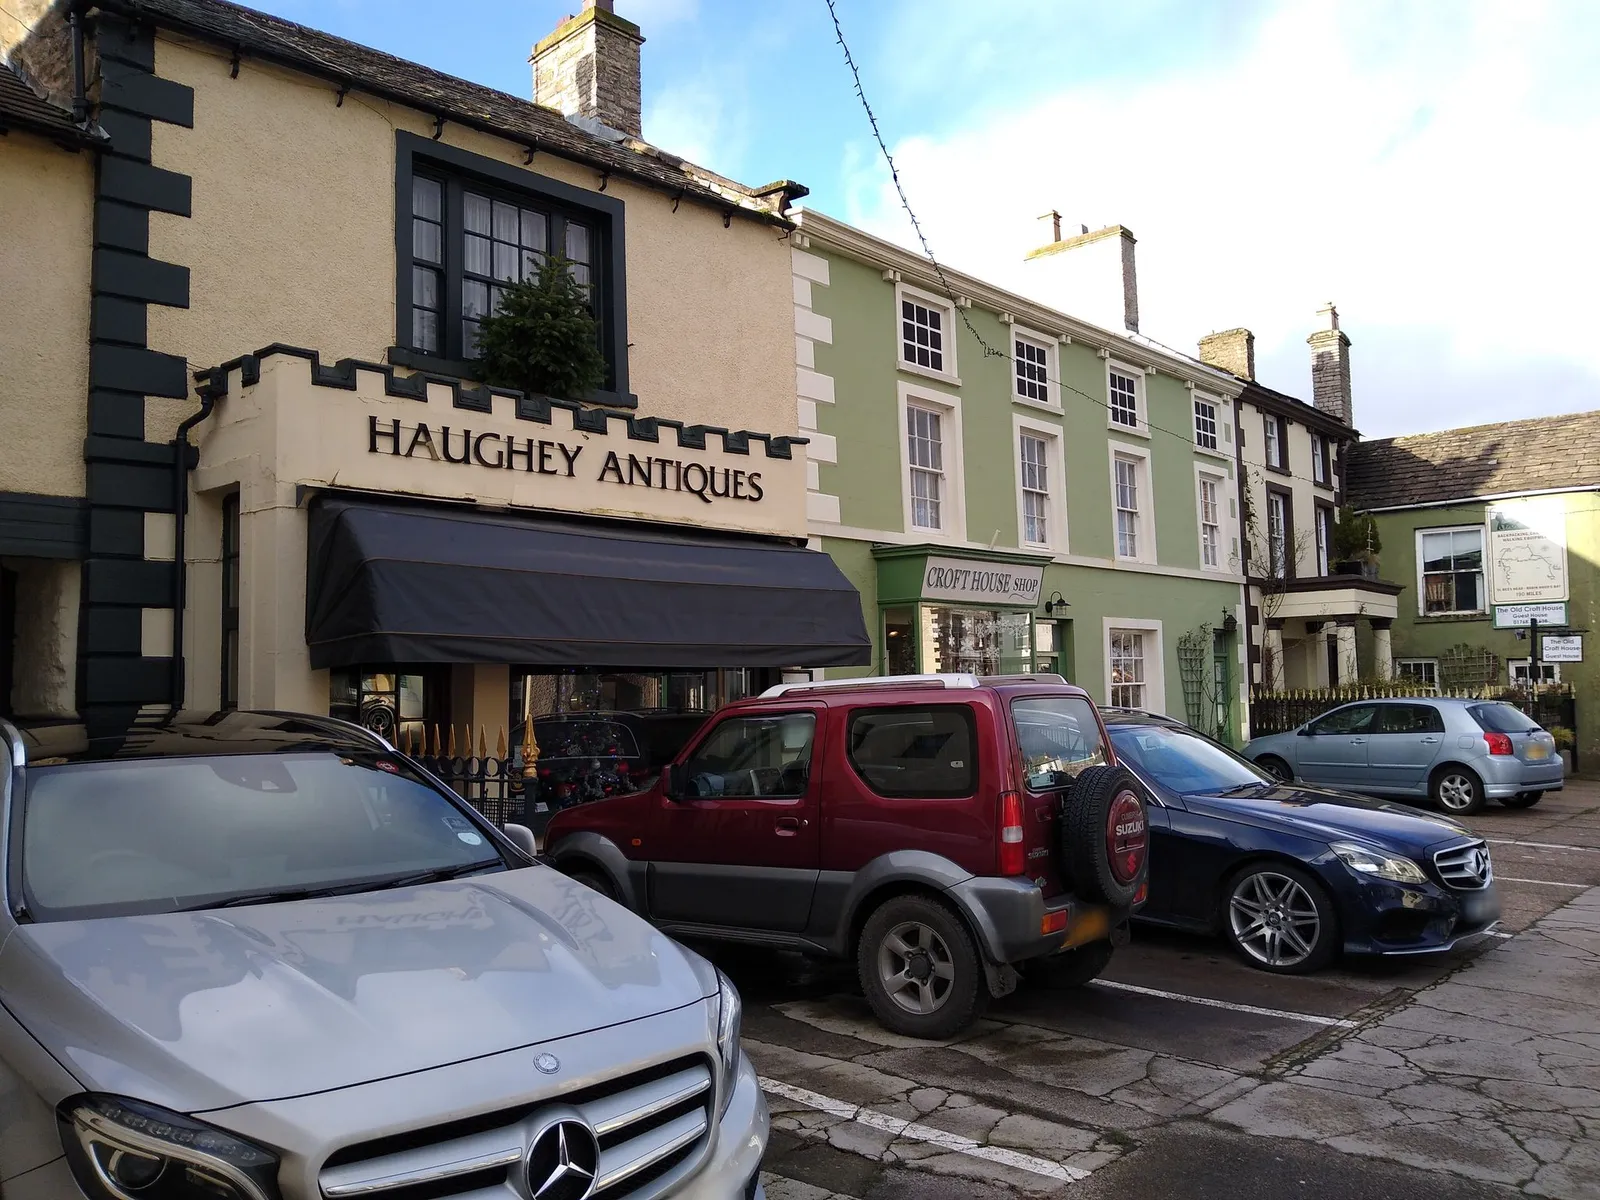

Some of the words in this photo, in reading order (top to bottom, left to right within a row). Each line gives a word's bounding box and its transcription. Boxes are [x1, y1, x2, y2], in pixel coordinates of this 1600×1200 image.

[368, 415, 584, 478] HAUGHEY
[597, 450, 765, 504] ANTIQUES
[927, 566, 971, 590] CROFT
[970, 570, 1012, 593] HOUSE
[1013, 577, 1038, 593] SHOP
[1116, 820, 1144, 836] SUZUKI
